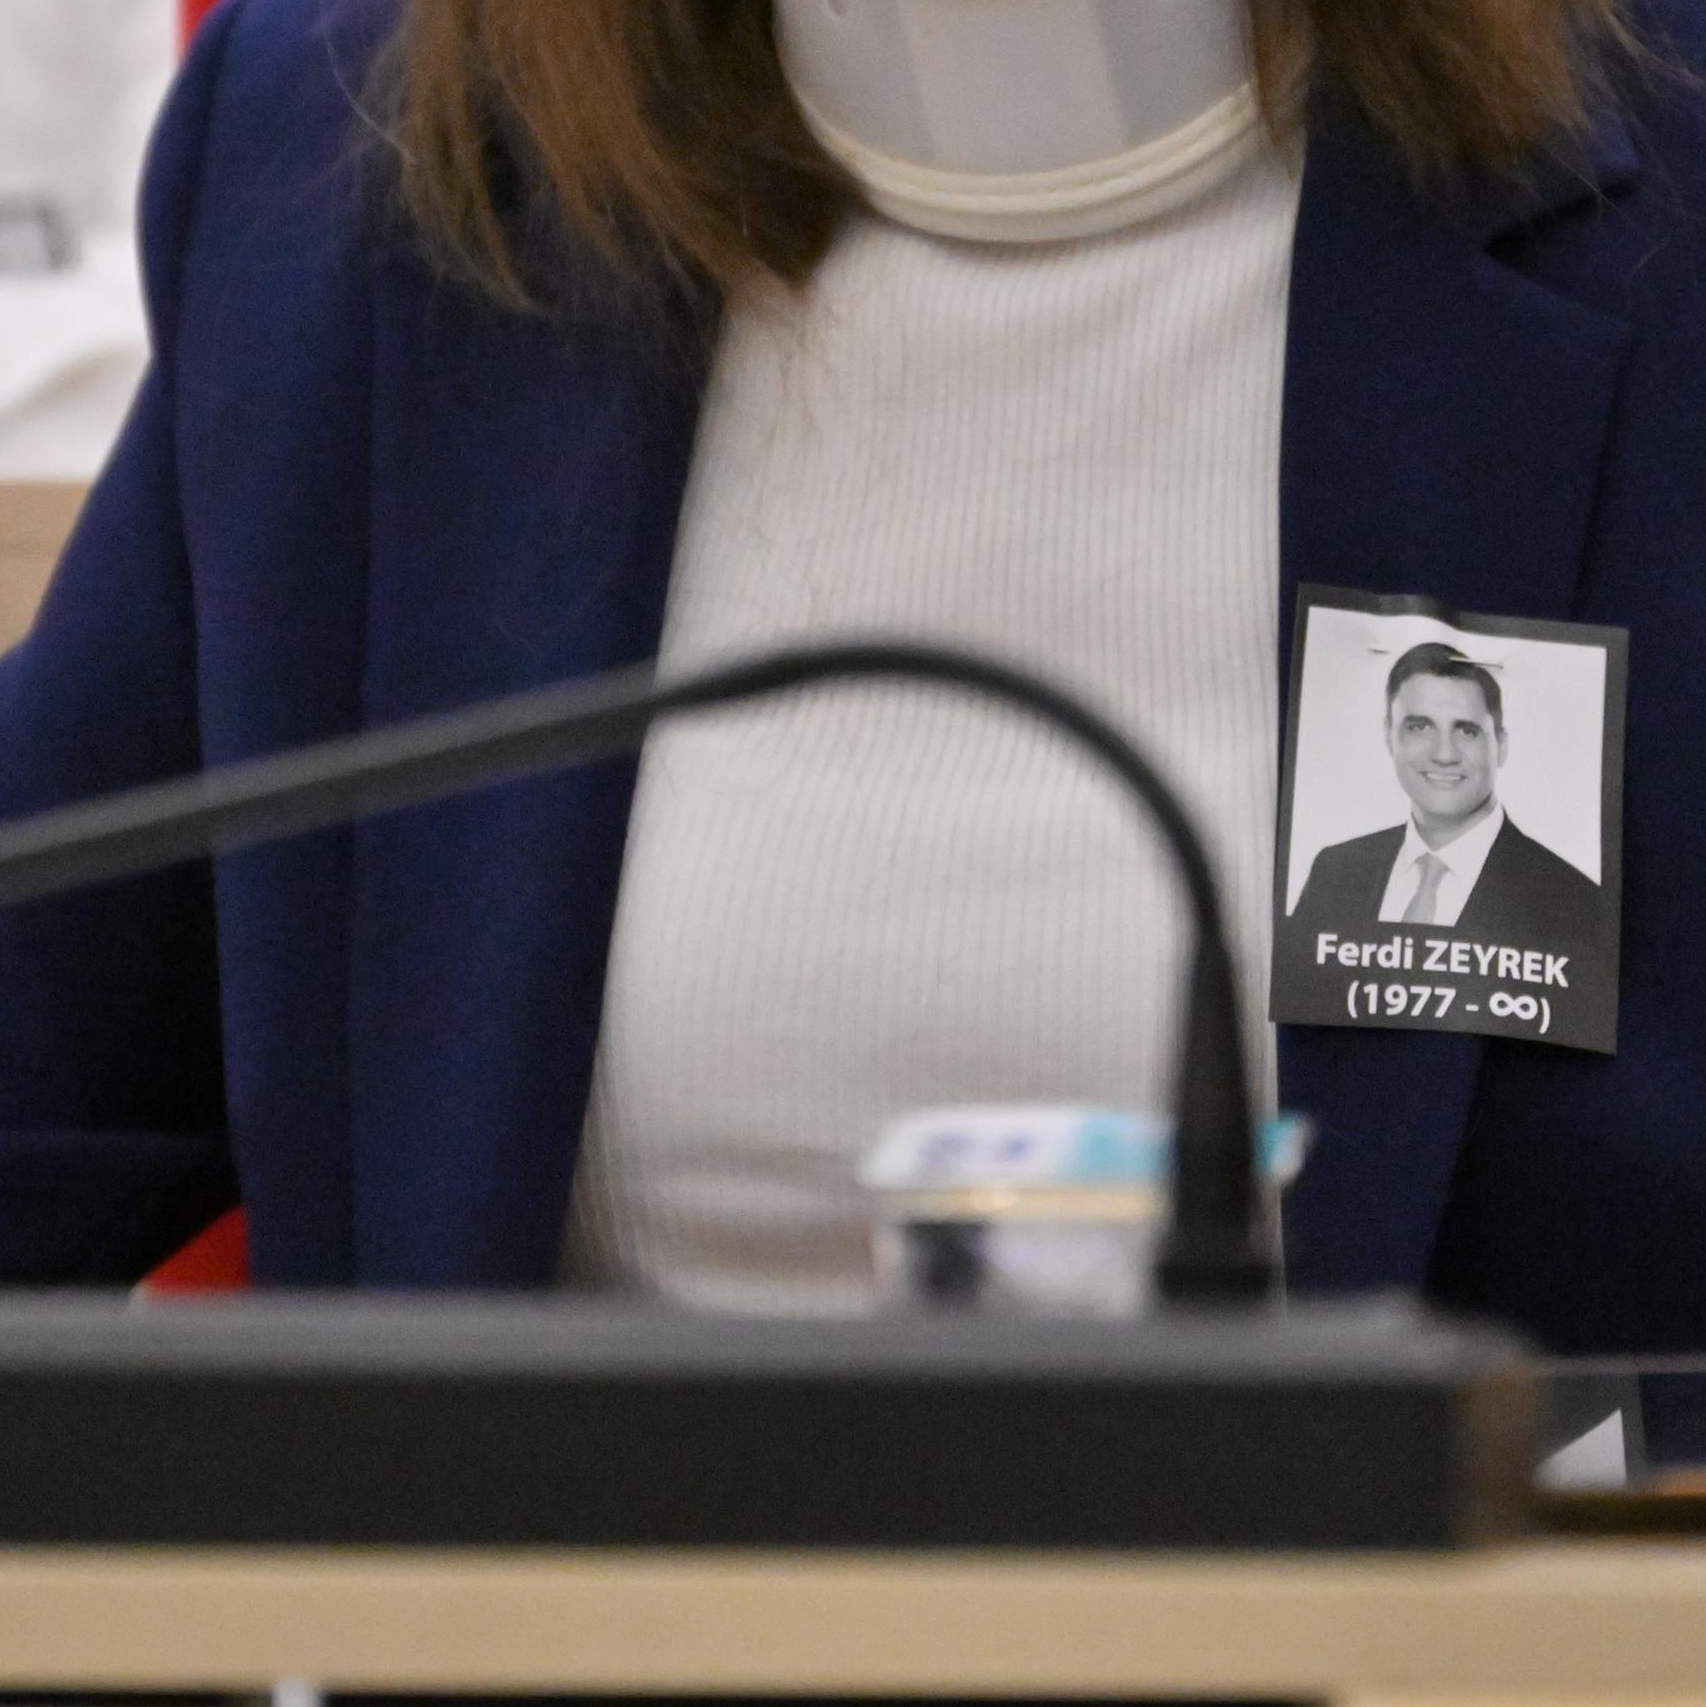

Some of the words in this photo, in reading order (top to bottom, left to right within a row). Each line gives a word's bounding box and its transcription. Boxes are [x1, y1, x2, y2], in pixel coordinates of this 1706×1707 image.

[1316, 932, 1415, 970] Ferdi
[1422, 939, 1570, 988] ZEYREK
[1347, 979, 1458, 1020] (1977
